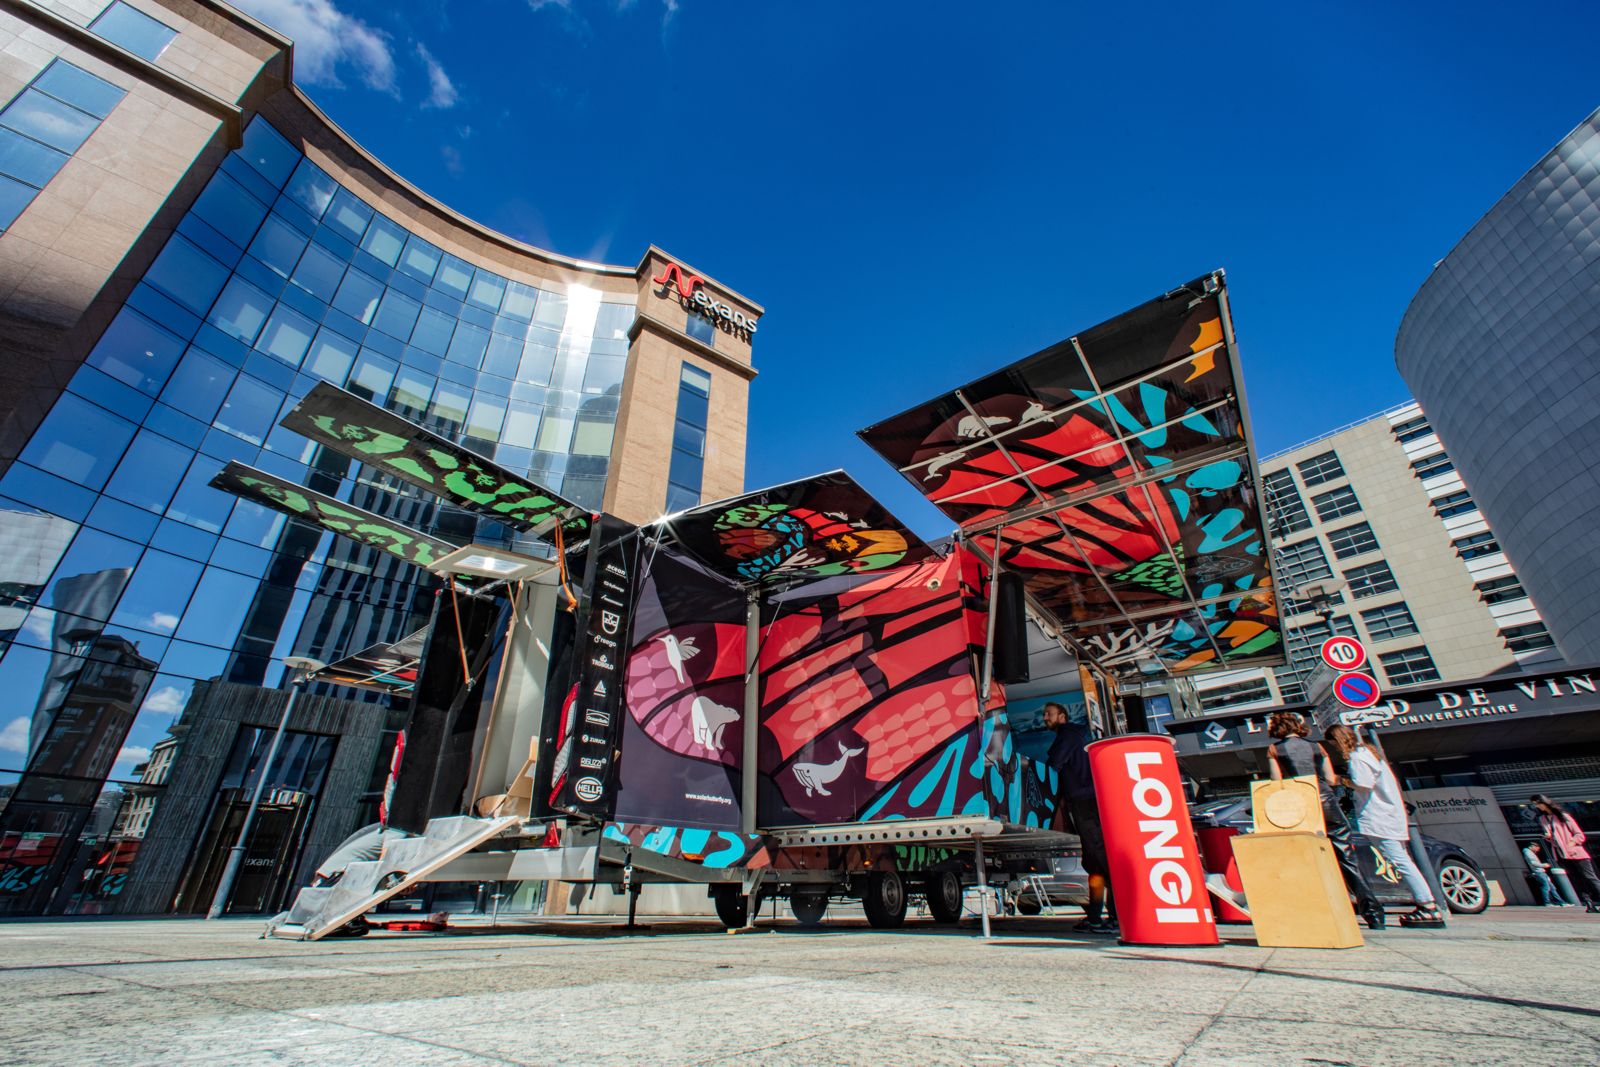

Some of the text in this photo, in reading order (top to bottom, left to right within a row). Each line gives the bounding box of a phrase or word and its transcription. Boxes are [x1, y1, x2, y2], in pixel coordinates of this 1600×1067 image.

[1332, 644, 1355, 661] 10
[1435, 673, 1597, 710] DE VIN
[1399, 703, 1519, 725] UNIVERSITAIRE
[578, 784, 603, 795] HELLA
